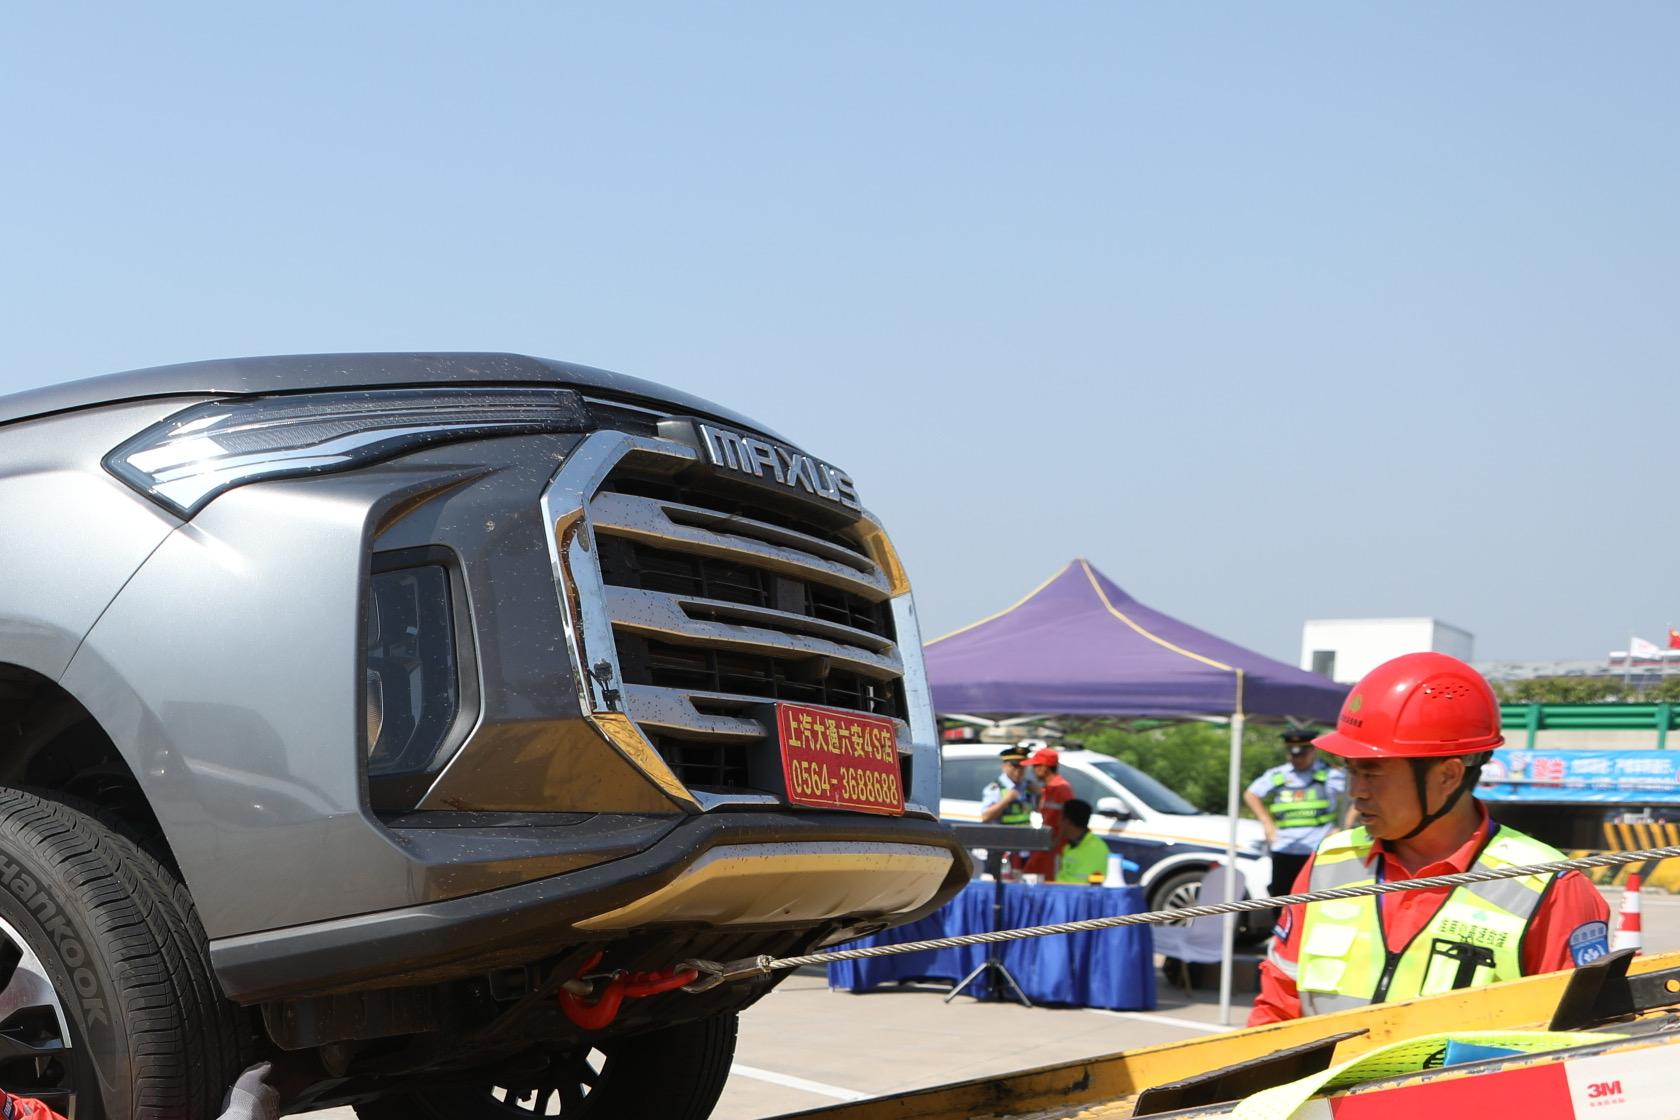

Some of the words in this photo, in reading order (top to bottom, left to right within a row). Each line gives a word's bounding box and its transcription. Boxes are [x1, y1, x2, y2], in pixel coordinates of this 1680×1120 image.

[700, 424, 863, 513] MAXUS
[788, 710, 894, 764] 上汽大通六安4S店
[791, 758, 898, 805] 0564-3688688
[1586, 1080, 1623, 1099] 3M
